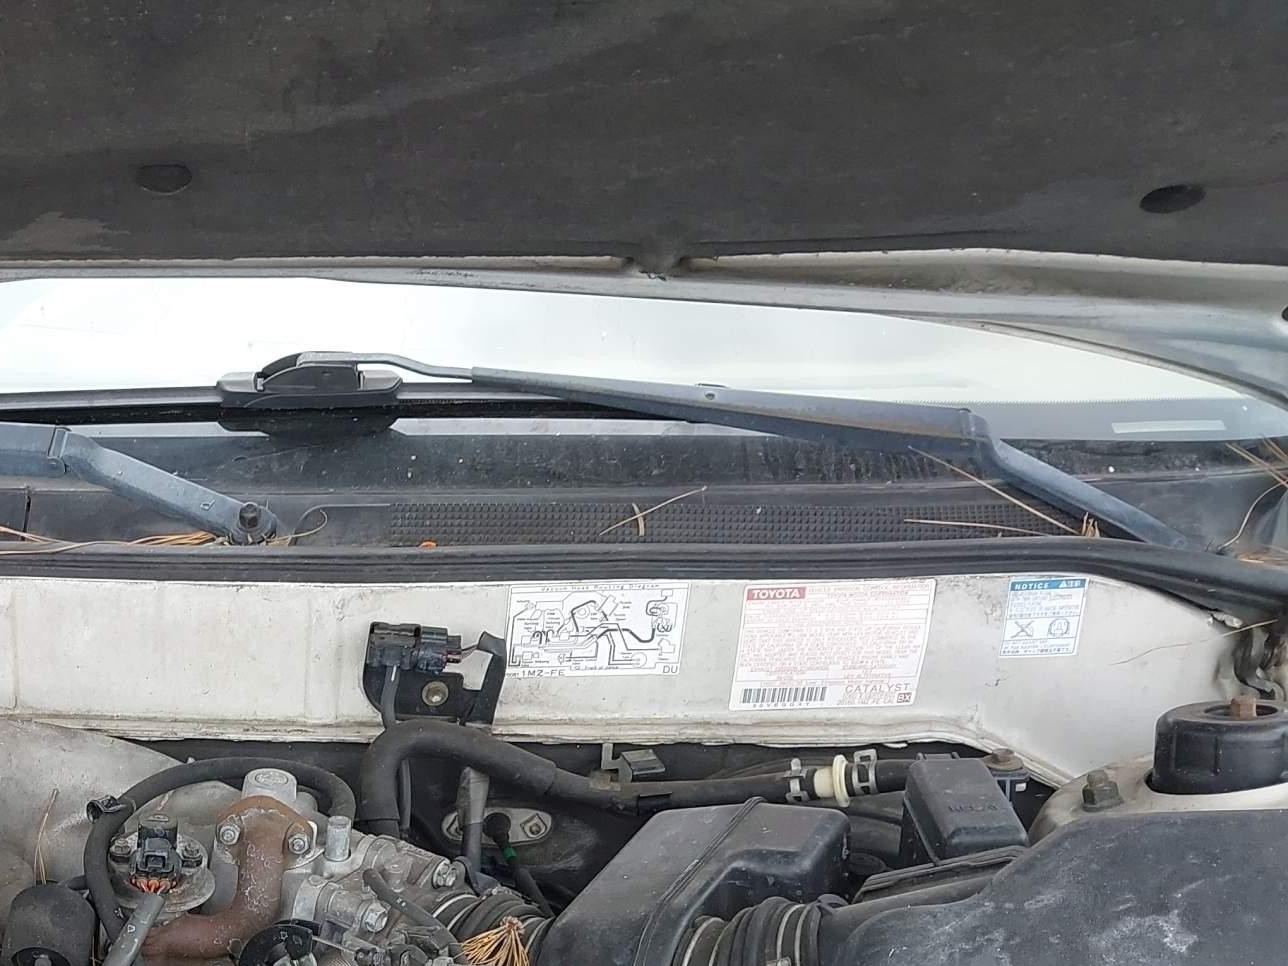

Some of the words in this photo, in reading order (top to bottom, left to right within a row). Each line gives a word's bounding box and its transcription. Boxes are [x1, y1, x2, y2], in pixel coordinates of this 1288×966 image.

[1015, 582, 1050, 590] NOTICE
[752, 589, 800, 600] TOYOTA
[522, 669, 565, 677] 1MZ-FE
[662, 664, 679, 674] DU
[845, 682, 911, 694] CATALYST
